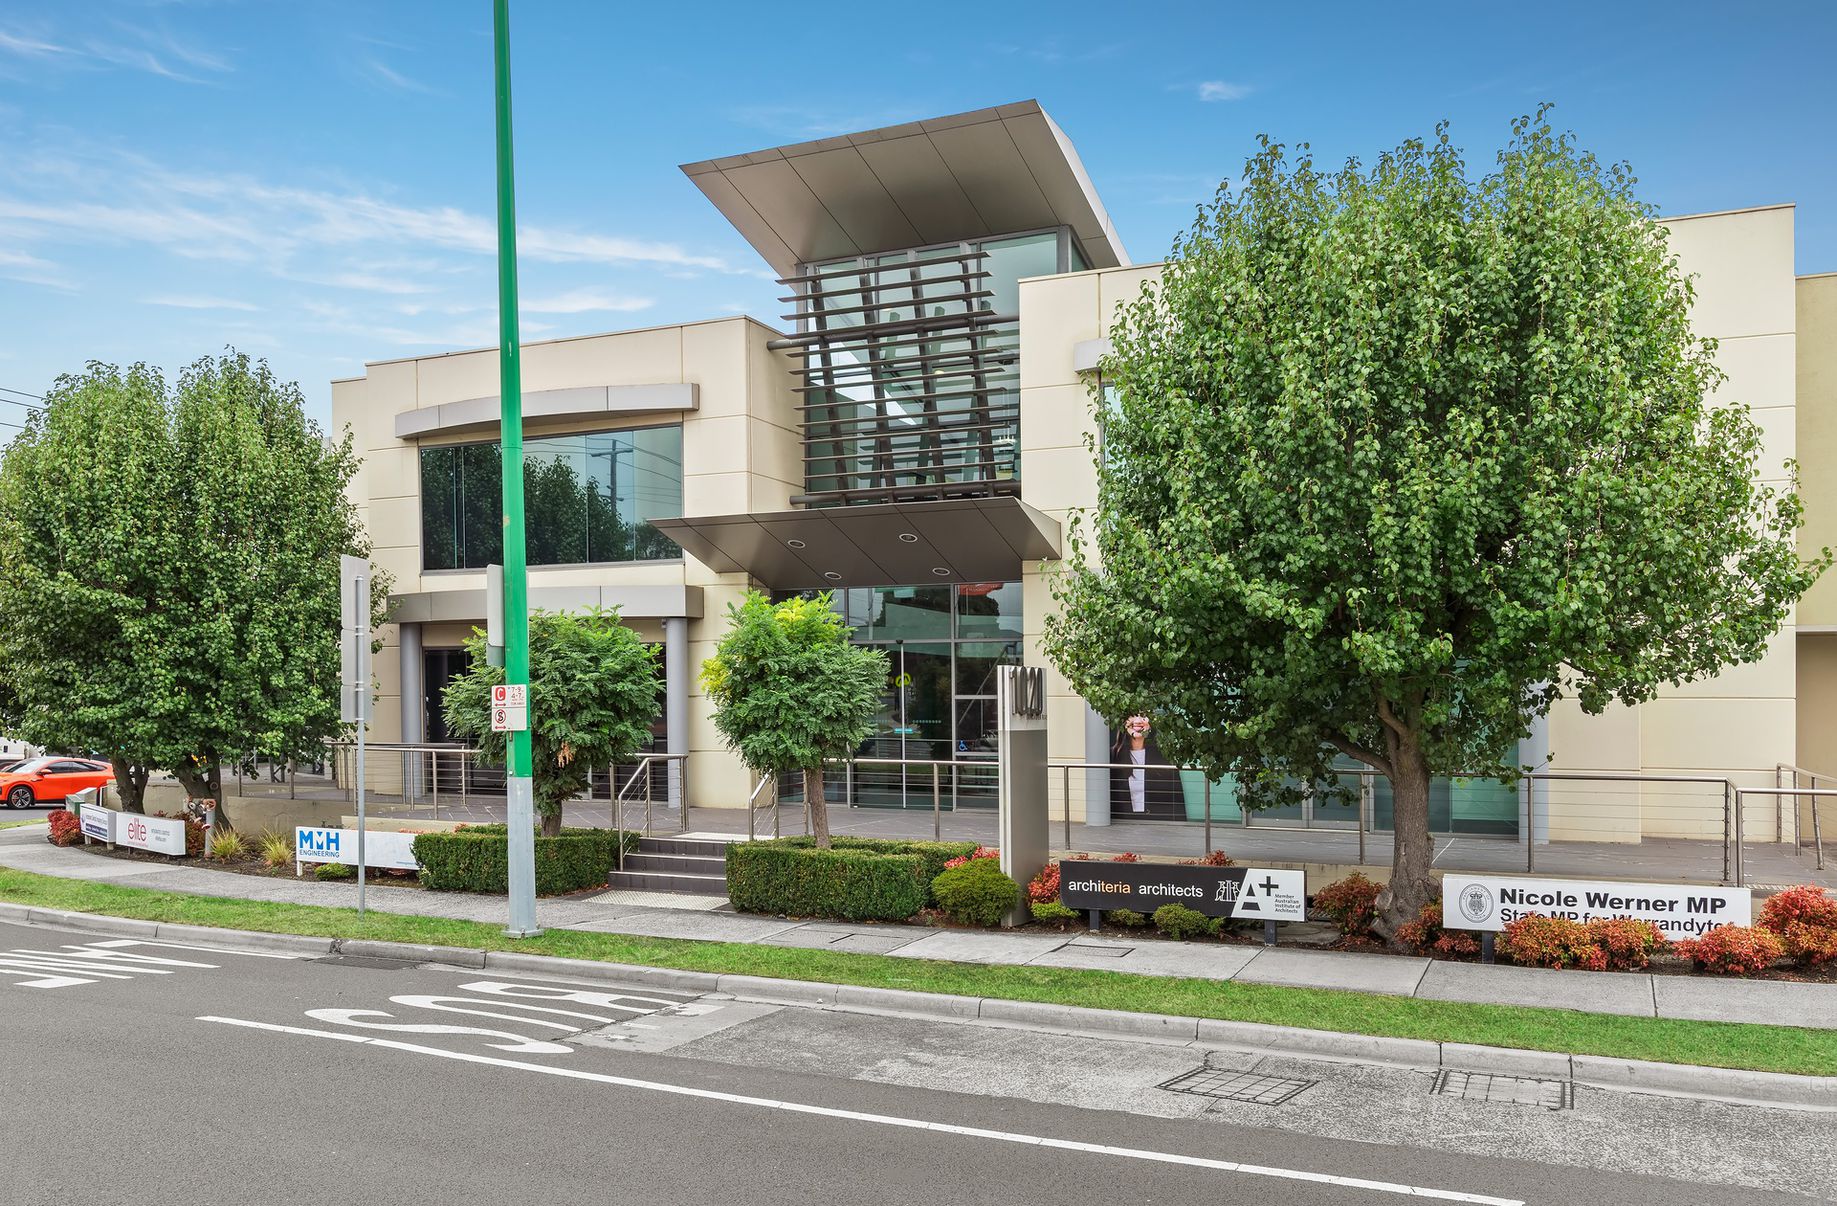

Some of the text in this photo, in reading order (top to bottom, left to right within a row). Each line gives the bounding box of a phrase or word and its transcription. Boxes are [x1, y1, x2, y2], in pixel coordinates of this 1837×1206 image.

[128, 818, 146, 842] elite
[299, 849, 340, 858] ENGINEERING
[1068, 879, 1204, 898] architeria architects
[1500, 888, 1726, 914] Nicole Werner MP
[1500, 908, 1545, 922] Sta
